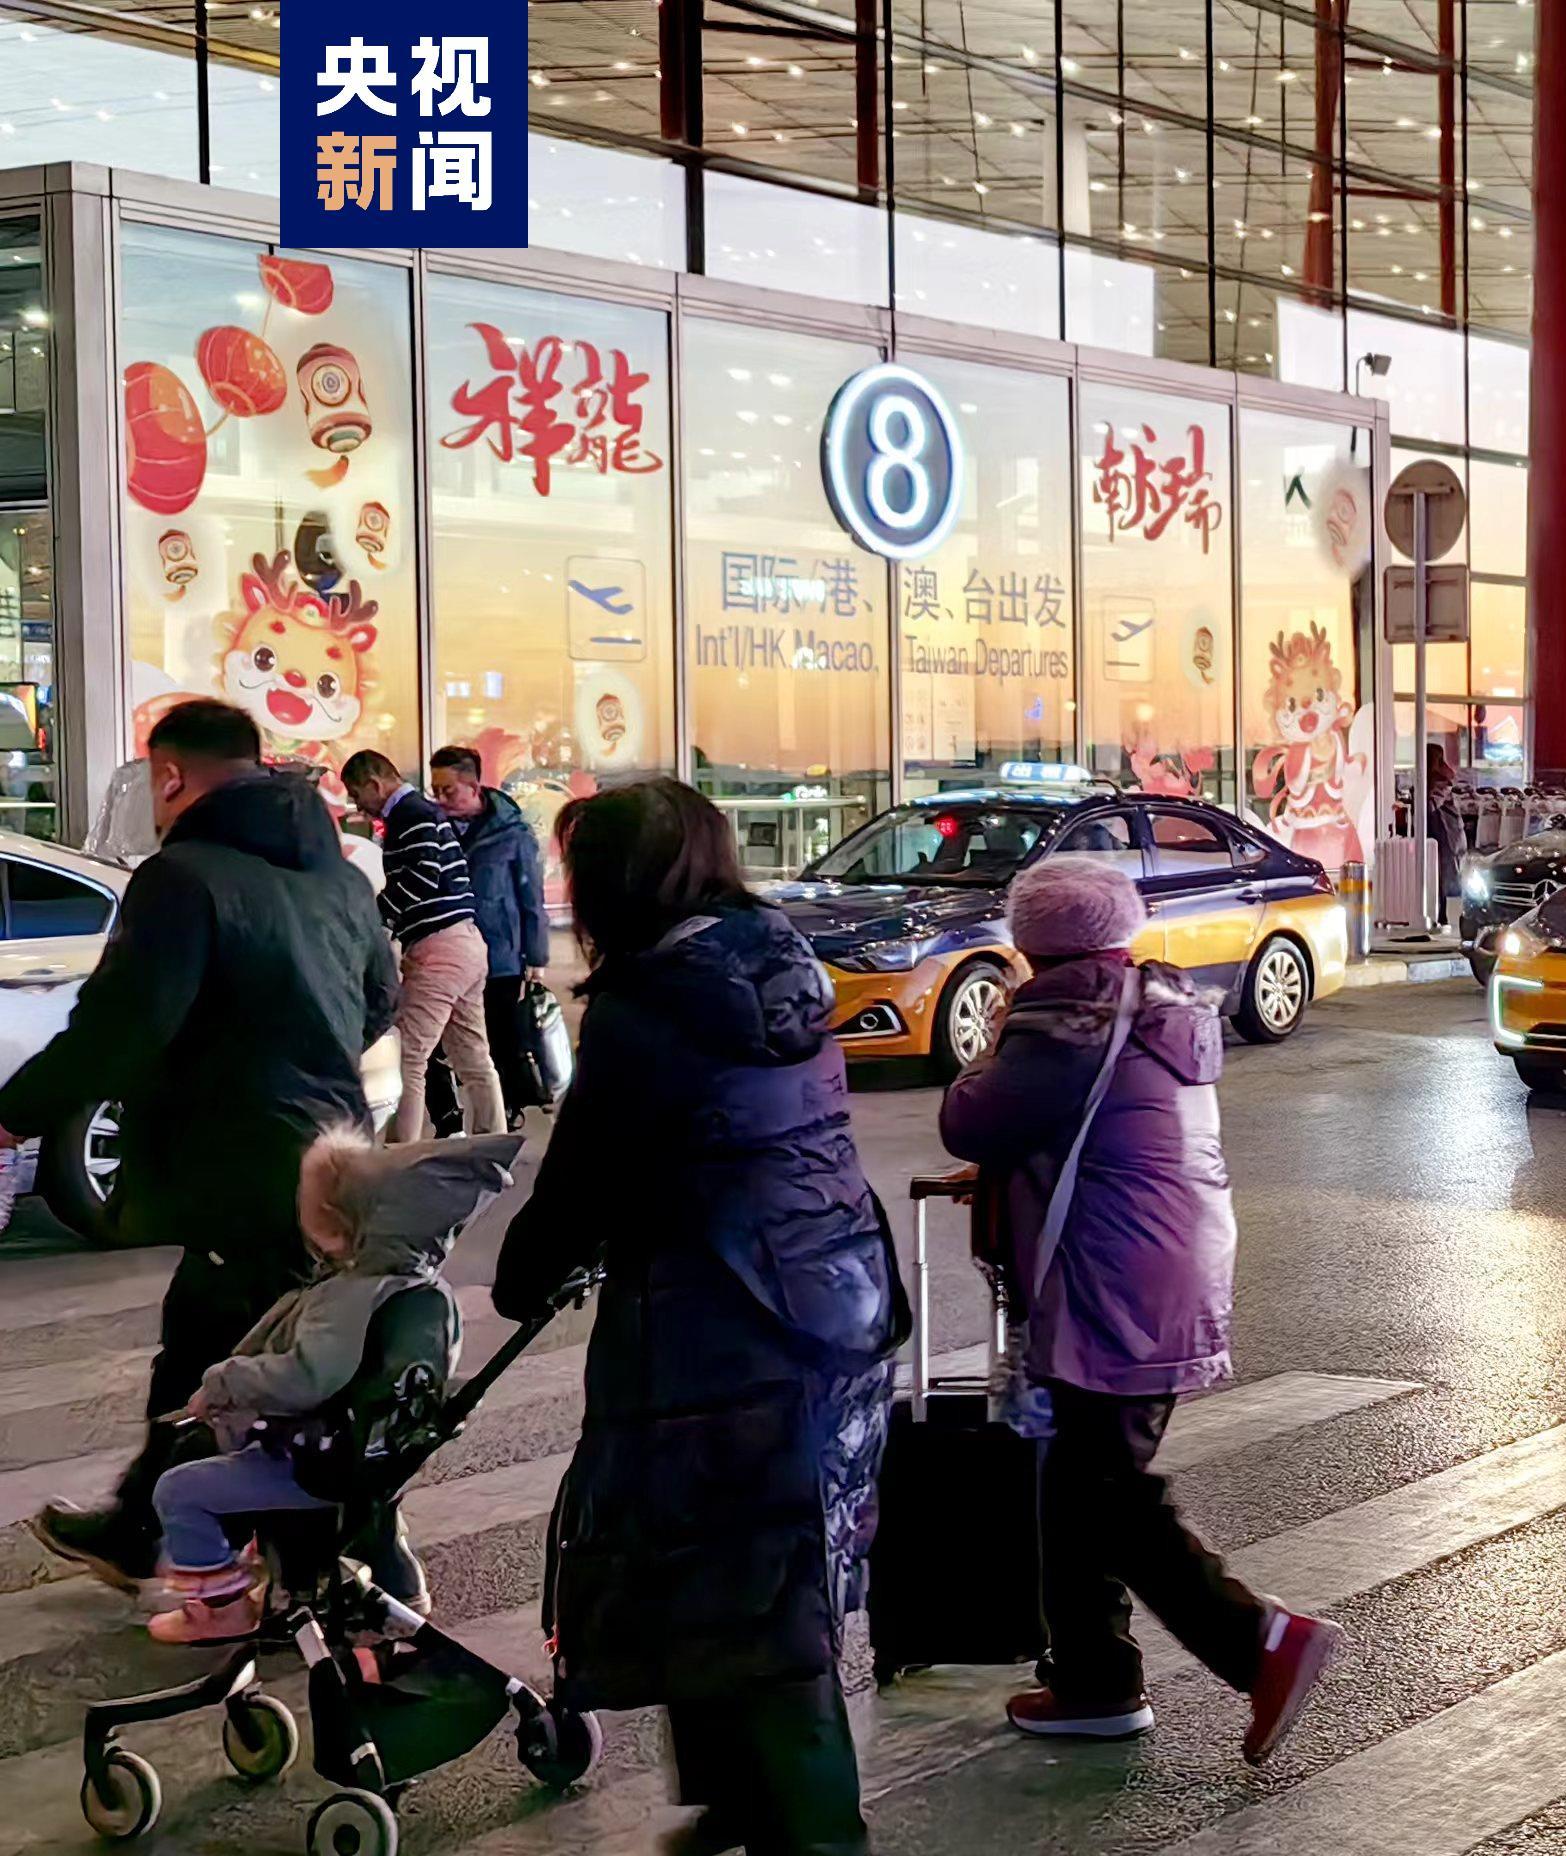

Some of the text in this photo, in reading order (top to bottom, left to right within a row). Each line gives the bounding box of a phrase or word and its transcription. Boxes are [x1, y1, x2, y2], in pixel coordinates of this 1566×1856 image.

[868, 395, 930, 529] 8
[904, 634, 969, 676] Taiwan
[974, 637, 1069, 687] Departures
